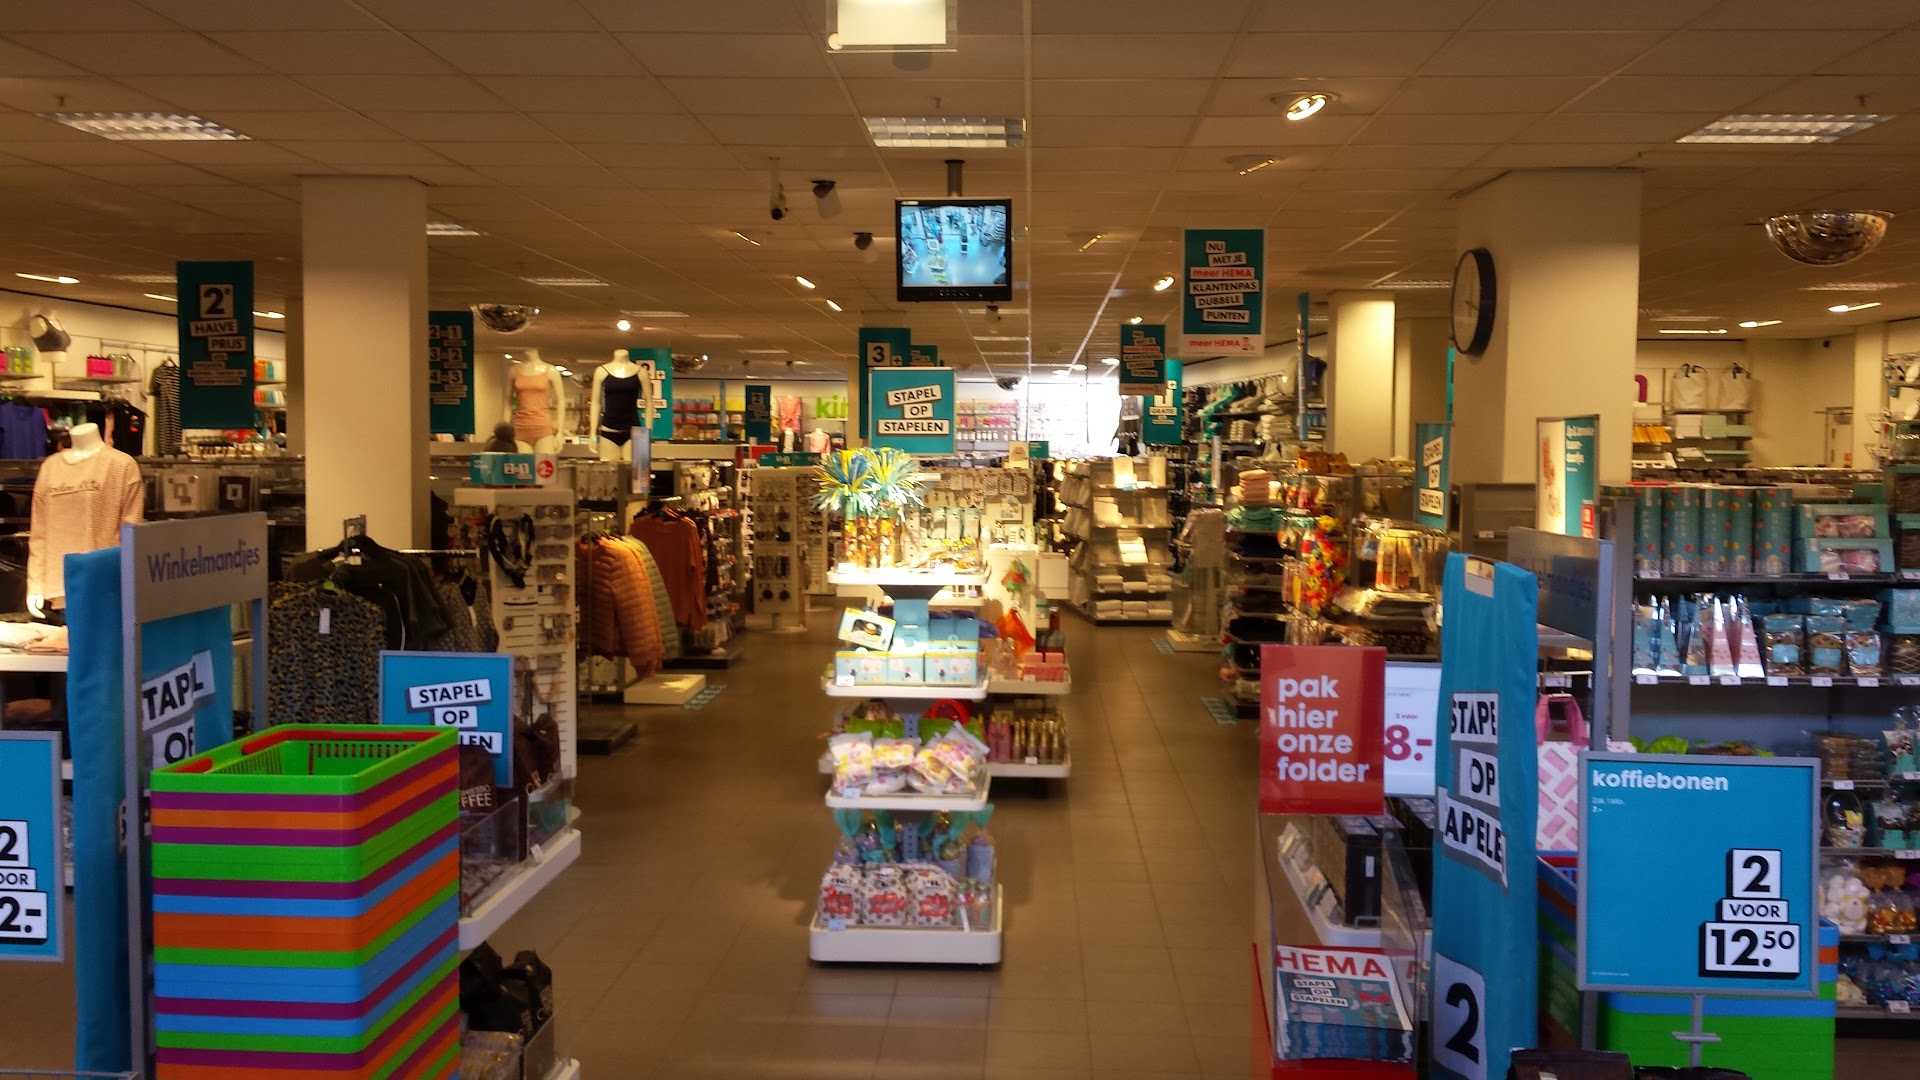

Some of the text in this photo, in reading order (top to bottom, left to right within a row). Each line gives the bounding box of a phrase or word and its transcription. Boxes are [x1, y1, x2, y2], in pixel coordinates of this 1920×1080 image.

[1208, 243, 1223, 251] NU
[1213, 254, 1243, 264] MET JE
[1221, 269, 1252, 277] HEMA
[1192, 281, 1257, 292] KLANTENPAS
[1198, 296, 1241, 306] DUBBELE
[1206, 312, 1245, 320] PUNTEN
[194, 321, 235, 334] HALVE
[211, 339, 242, 349] PRIJS
[872, 345, 885, 363] 3
[894, 388, 937, 402] STAPEL
[910, 406, 928, 416] OP
[884, 422, 944, 432] STAPELEN
[146, 538, 261, 583] Winkelmandjes
[419, 683, 483, 704] STAPEL
[1278, 675, 1339, 702] pak
[442, 710, 470, 724] OP
[1278, 702, 1338, 728] hier
[1278, 733, 1353, 753] onze
[1277, 756, 1370, 782] folder
[1470, 758, 1496, 796] OP
[1592, 769, 1729, 791] koffiebonen
[1742, 855, 1771, 893] 2
[1729, 904, 1781, 918] VOOR
[1711, 928, 1795, 968] 12.50
[1276, 951, 1388, 978] HEMA
[1293, 994, 1346, 1005] STAPELEN
[1445, 982, 1480, 1064] 2
